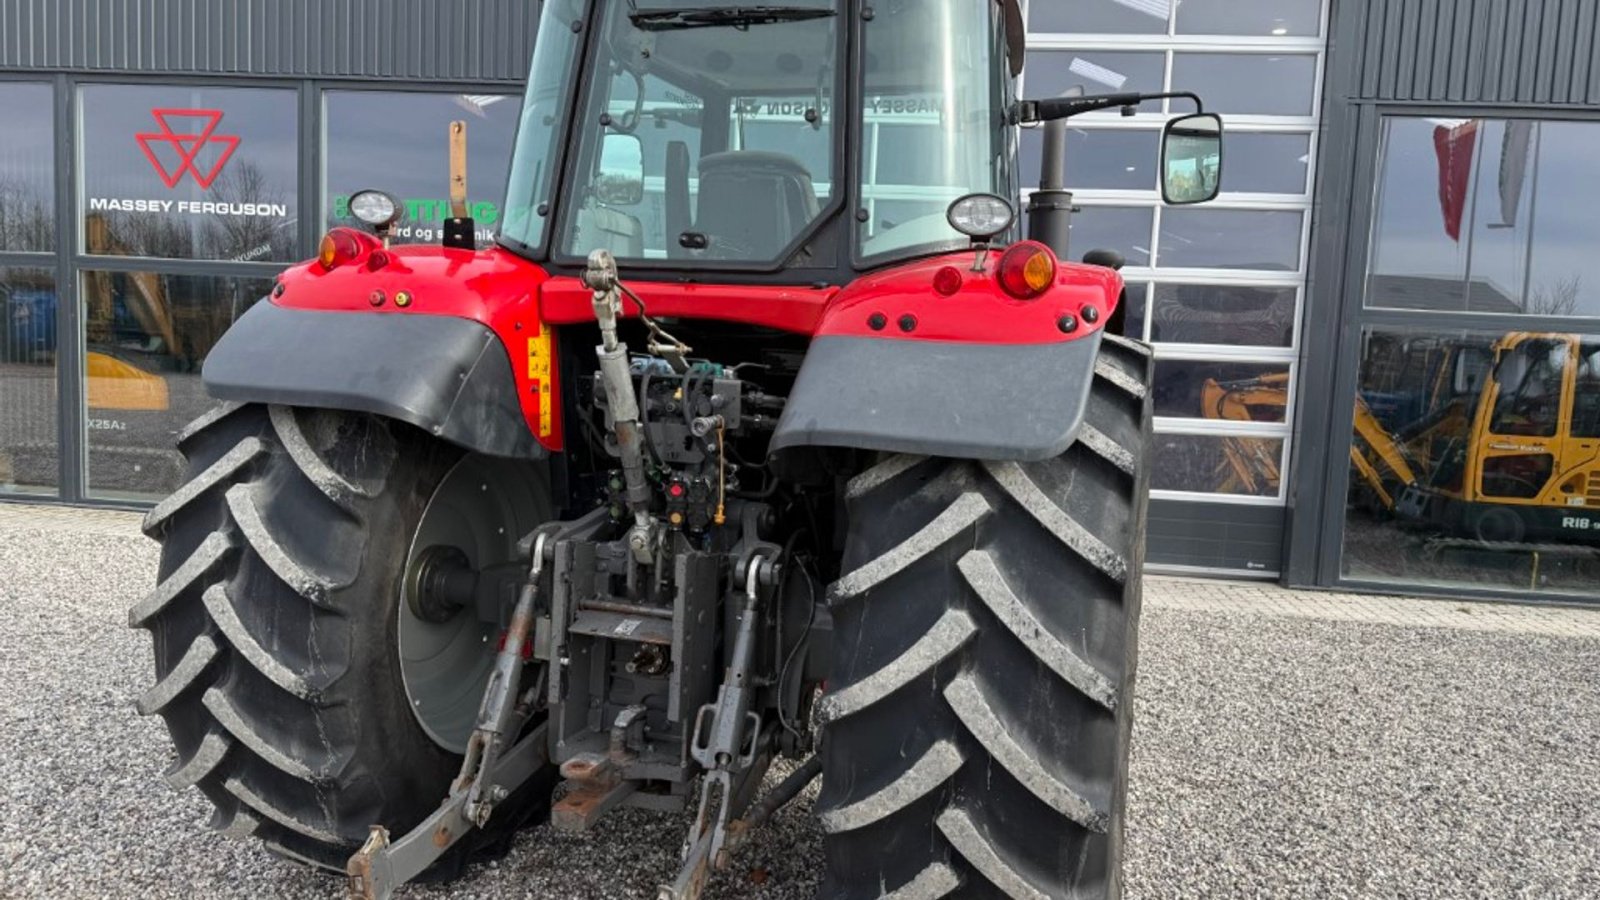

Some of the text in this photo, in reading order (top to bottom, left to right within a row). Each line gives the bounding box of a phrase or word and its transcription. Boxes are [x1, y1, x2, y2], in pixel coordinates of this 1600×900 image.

[90, 198, 287, 216] MASSEY FERGUSON
[415, 228, 433, 241] og
